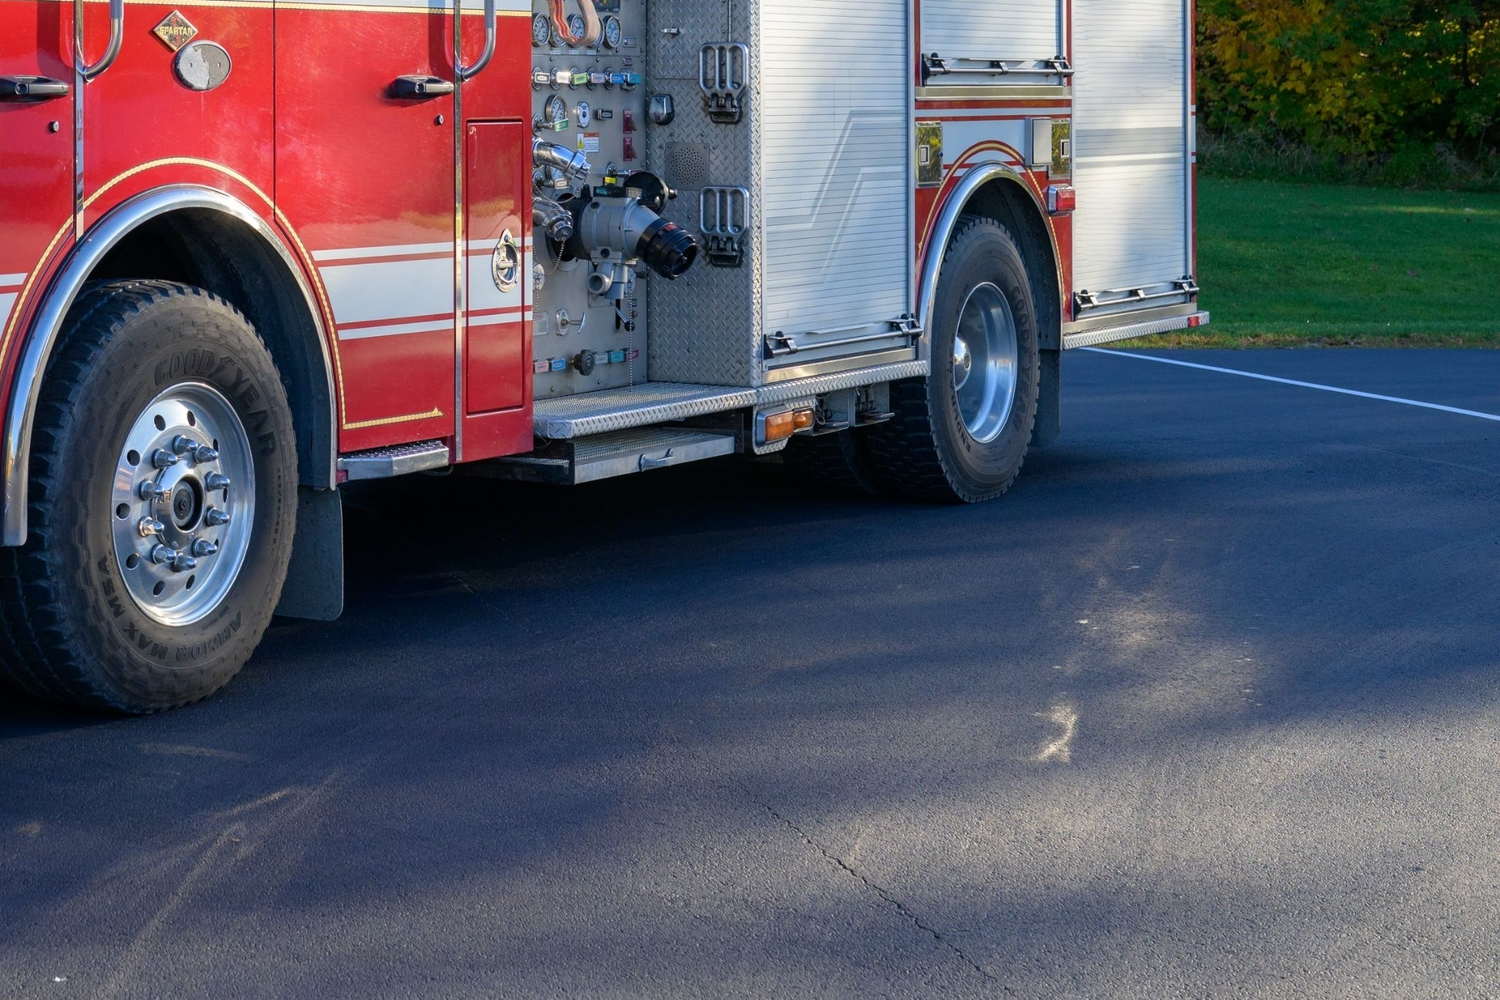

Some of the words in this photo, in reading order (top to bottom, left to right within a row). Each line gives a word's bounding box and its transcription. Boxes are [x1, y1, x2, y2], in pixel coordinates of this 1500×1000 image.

[159, 26, 193, 36] SPARTAN
[1011, 285, 1031, 433] GOODYEAR
[154, 347, 277, 456] GOODYEAR
[97, 556, 125, 619] MSA
[123, 621, 169, 661] MAX
[175, 609, 243, 662] ARMOR
